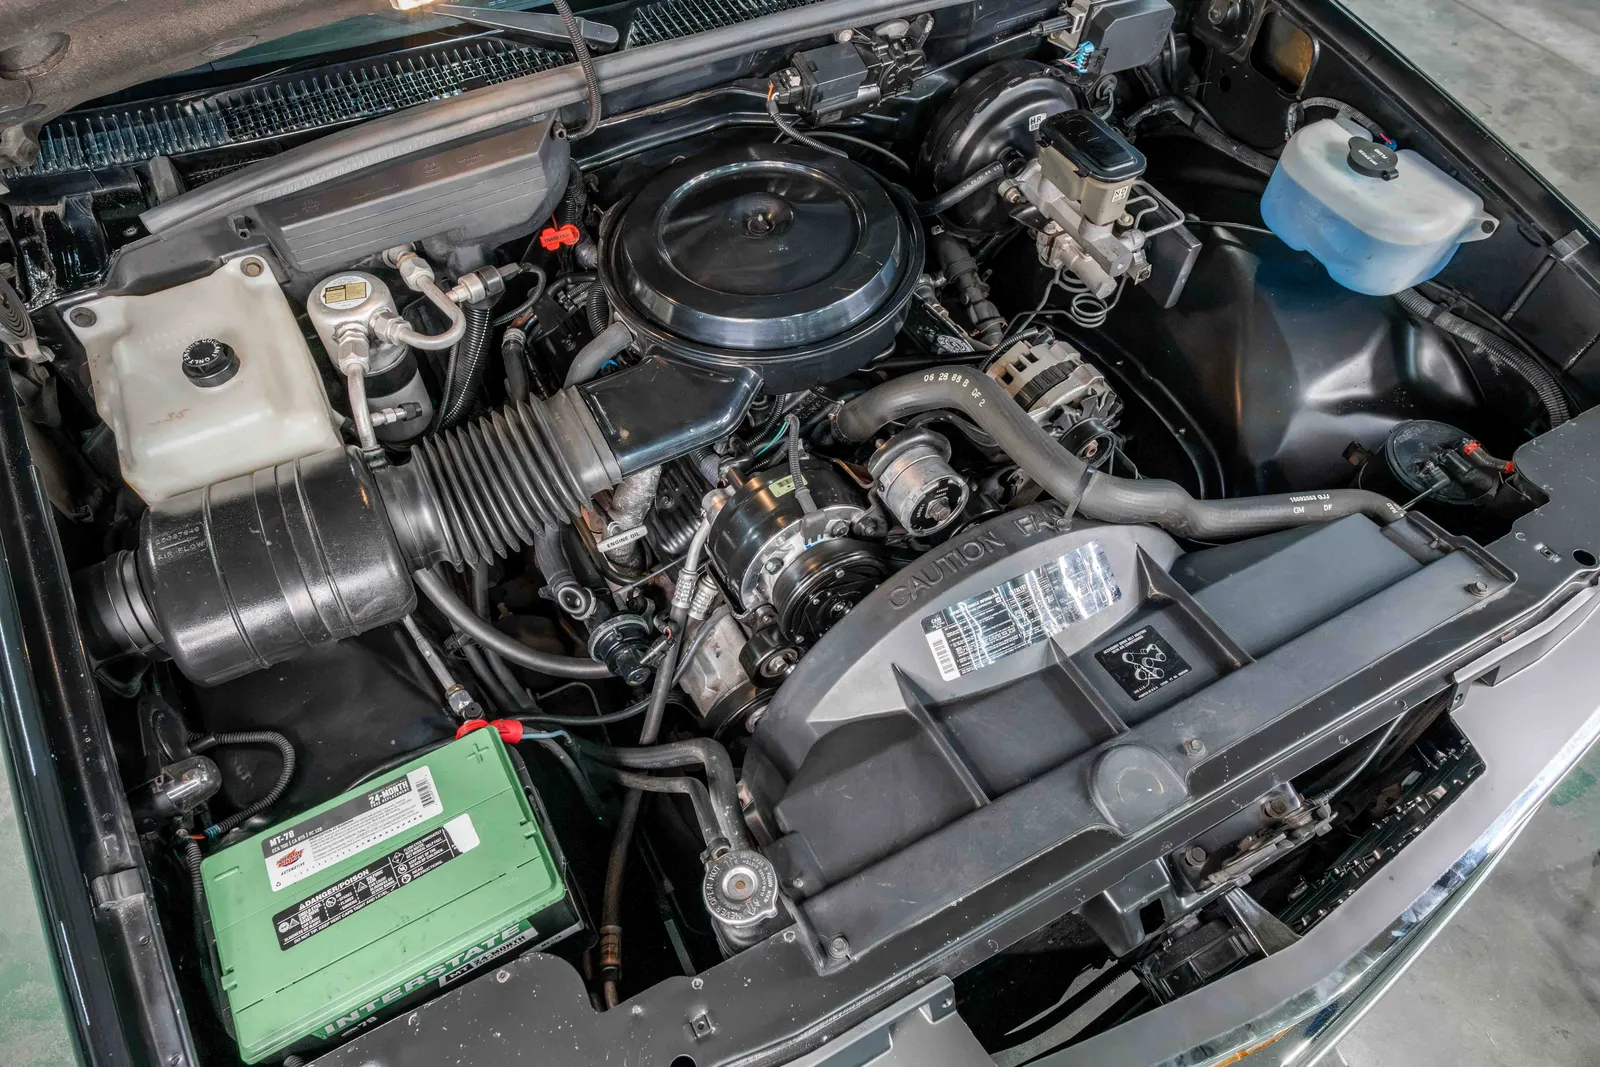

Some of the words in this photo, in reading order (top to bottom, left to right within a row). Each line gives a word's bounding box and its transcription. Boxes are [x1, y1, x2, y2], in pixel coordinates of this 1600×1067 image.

[188, 356, 211, 364] ONLY
[607, 535, 628, 548] ENGINE
[630, 531, 640, 539] OIL
[889, 531, 1006, 610] CAUTION
[369, 780, 409, 805] 24-MONTH
[281, 862, 306, 876] AUTOMOTIVE
[412, 867, 424, 875] READ
[708, 865, 720, 881] HOT
[305, 869, 370, 908] DANGER/POISON
[706, 883, 717, 906] OPEN
[715, 906, 741, 920] NEVER
[324, 923, 521, 1034] INTERSTATE
[449, 965, 469, 978] MT
